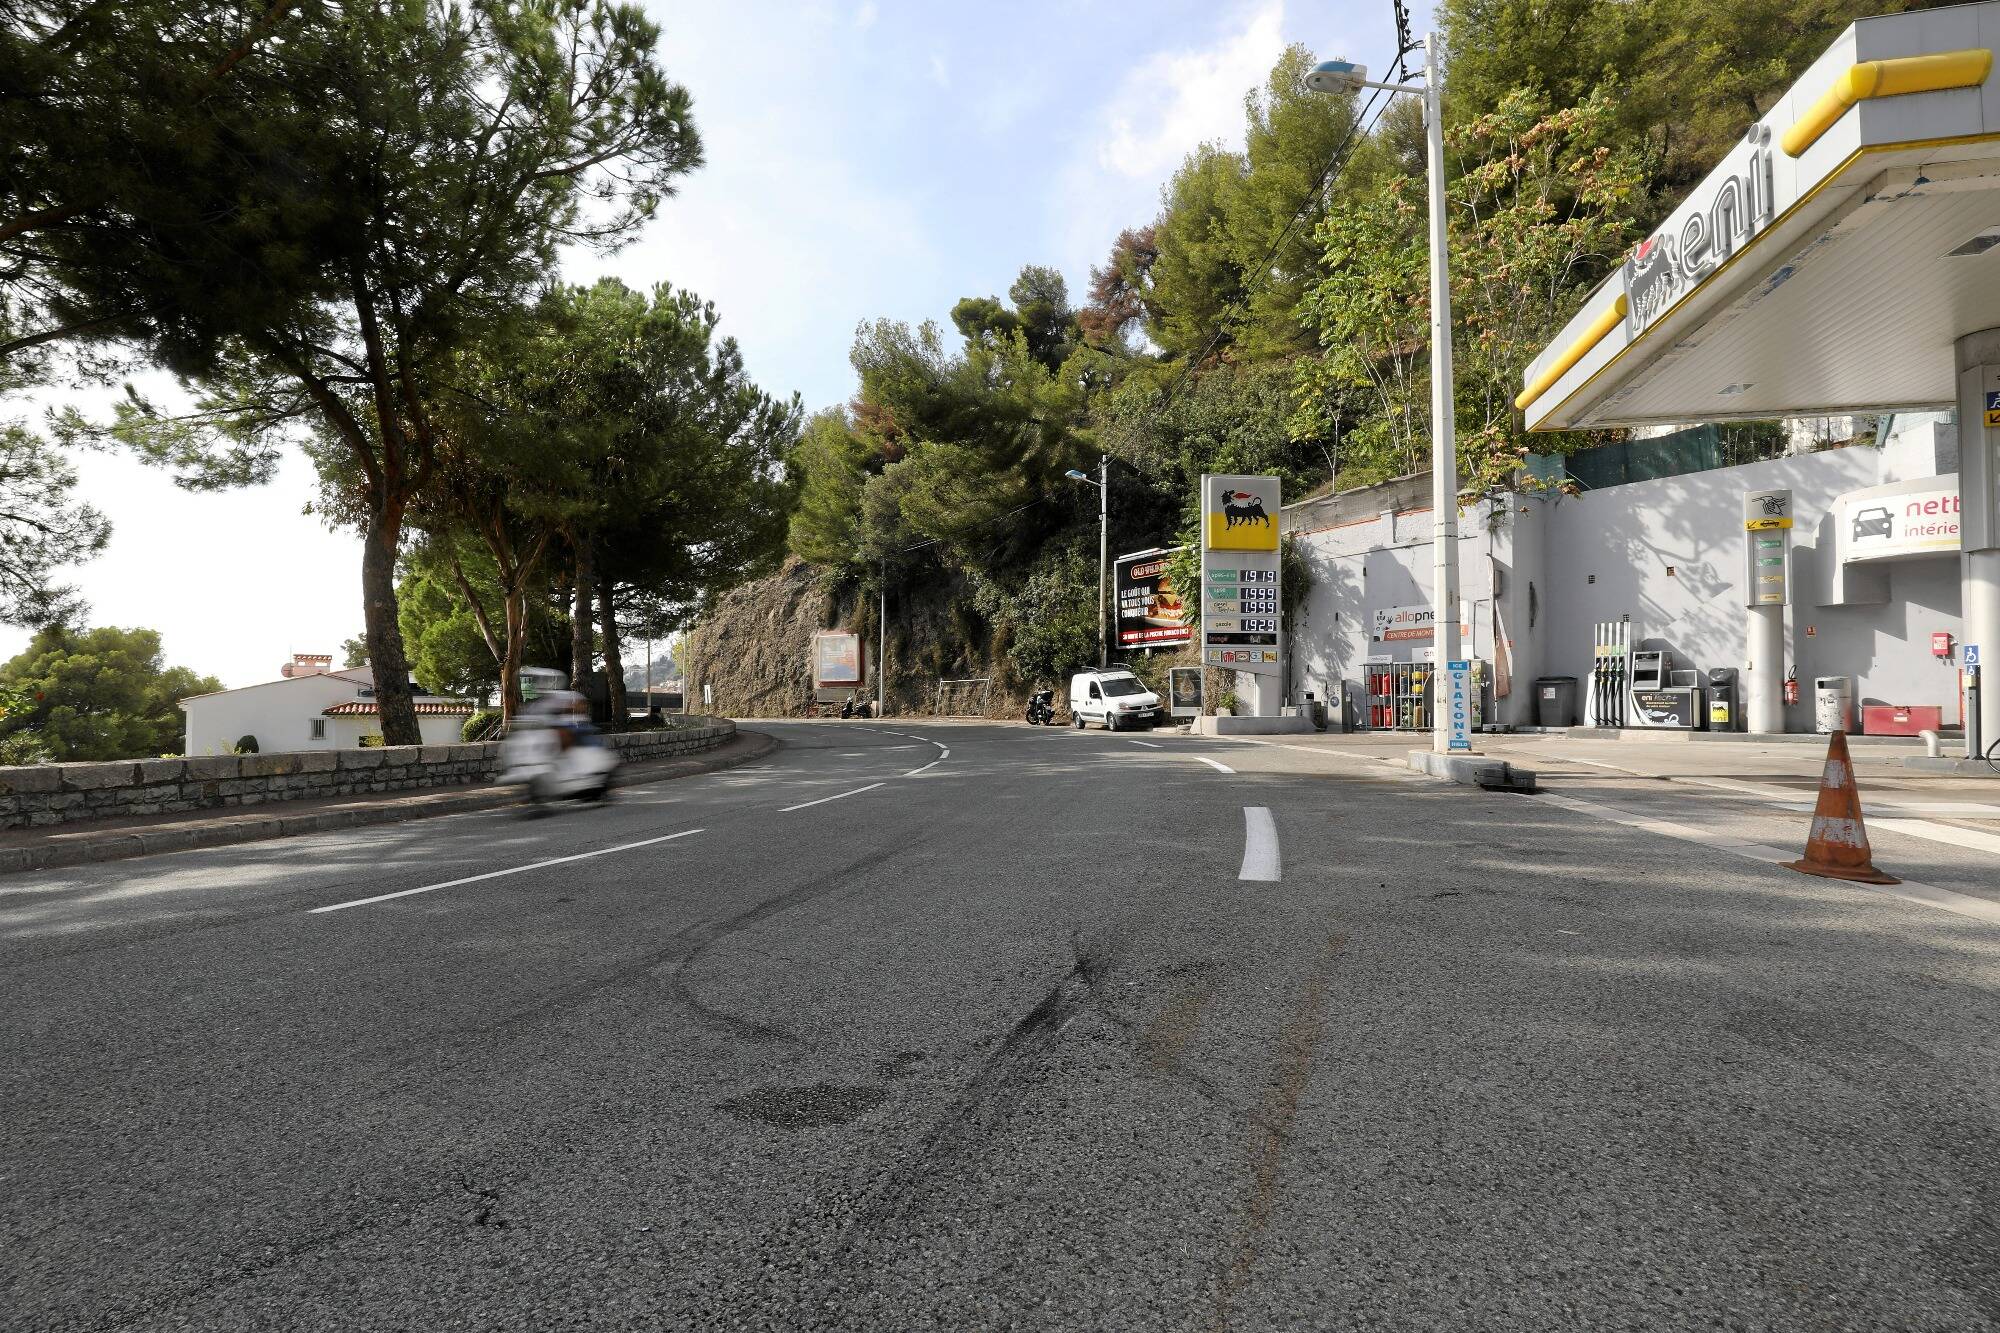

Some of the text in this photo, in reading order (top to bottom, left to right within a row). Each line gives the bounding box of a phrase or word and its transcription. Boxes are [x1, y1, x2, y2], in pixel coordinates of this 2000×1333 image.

[1680, 123, 1768, 281] eni
[1906, 495, 1960, 517] nett
[1904, 521, 1959, 537] intérie
[1133, 568, 1145, 577] OLD
[1245, 570, 1275, 582] 1.919
[1121, 590, 1128, 599] LE
[1245, 588, 1275, 600] 1.999
[1245, 602, 1275, 614] 1.999
[1245, 620, 1275, 632] 1.929
[1386, 631, 1408, 639] CENTRE
[1641, 693, 1653, 701] eni
